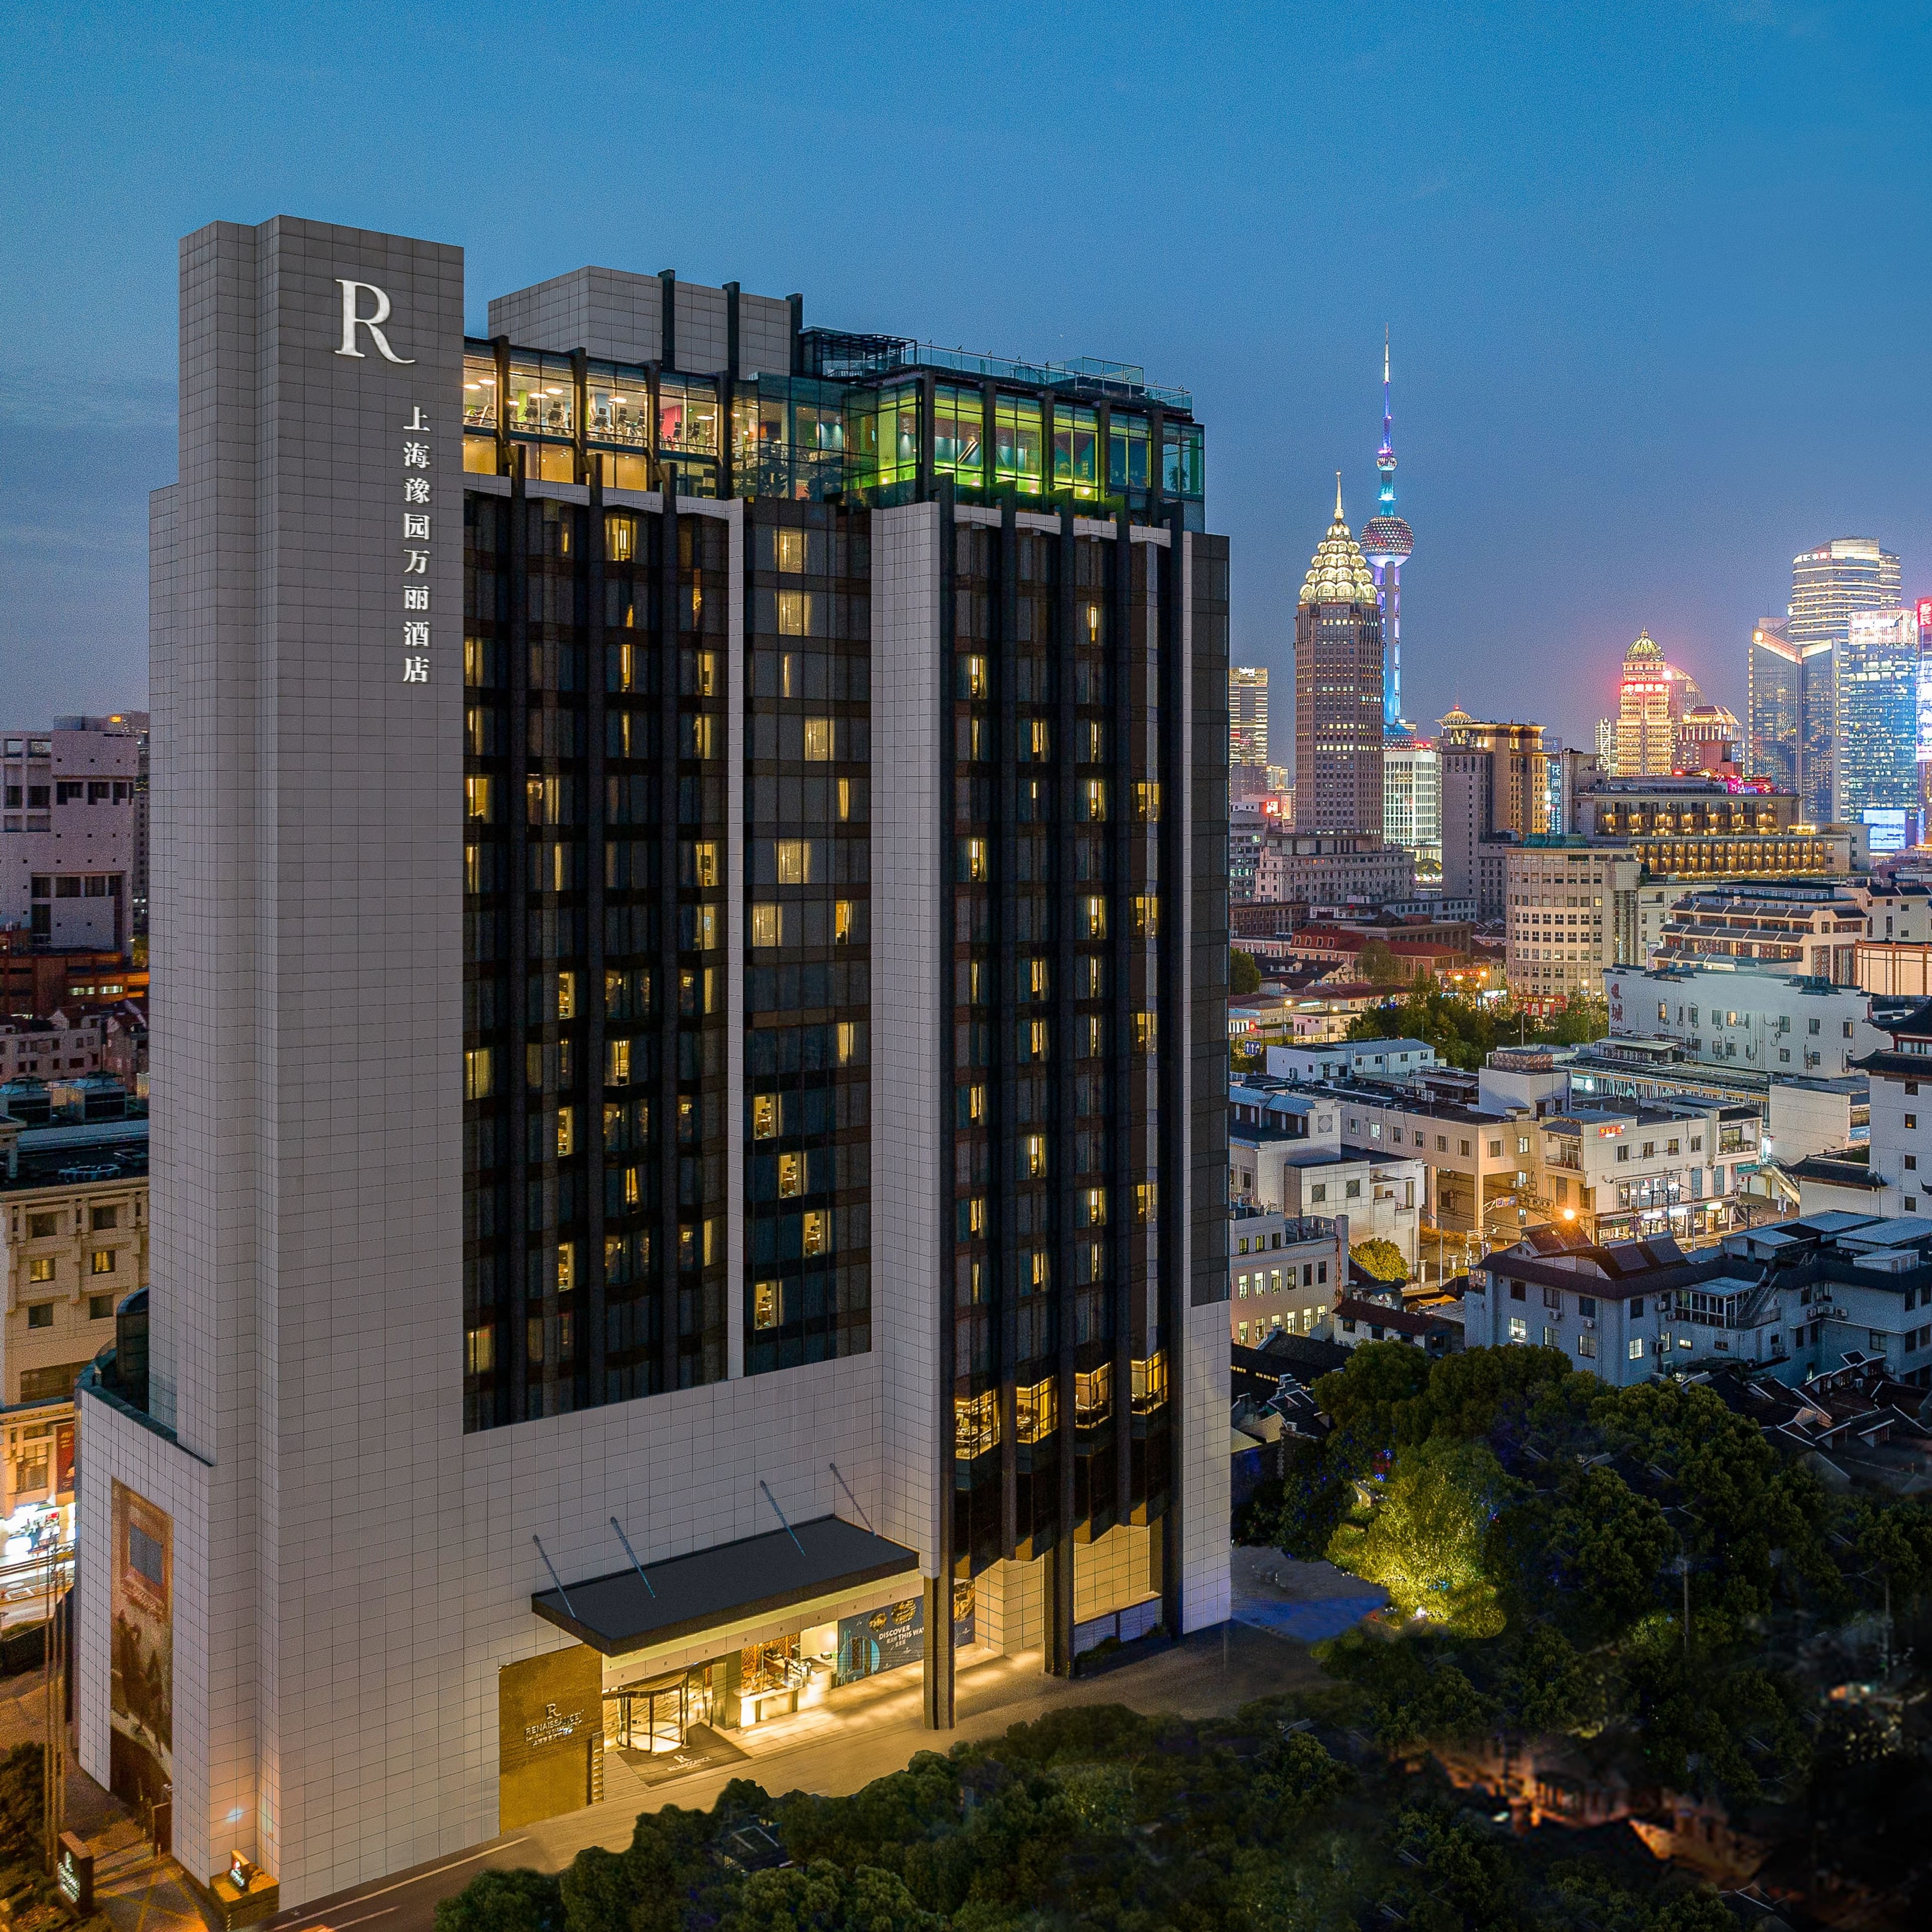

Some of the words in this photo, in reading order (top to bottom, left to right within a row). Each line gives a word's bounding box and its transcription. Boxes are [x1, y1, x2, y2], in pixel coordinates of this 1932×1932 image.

[335, 279, 416, 364] R
[403, 406, 431, 684] 上海豫园万丽酒店
[1551, 764, 1561, 803] 花间堂
[879, 1625, 910, 1640] DISCOVER
[898, 1631, 912, 1640] THIS
[546, 1703, 562, 1720] R
